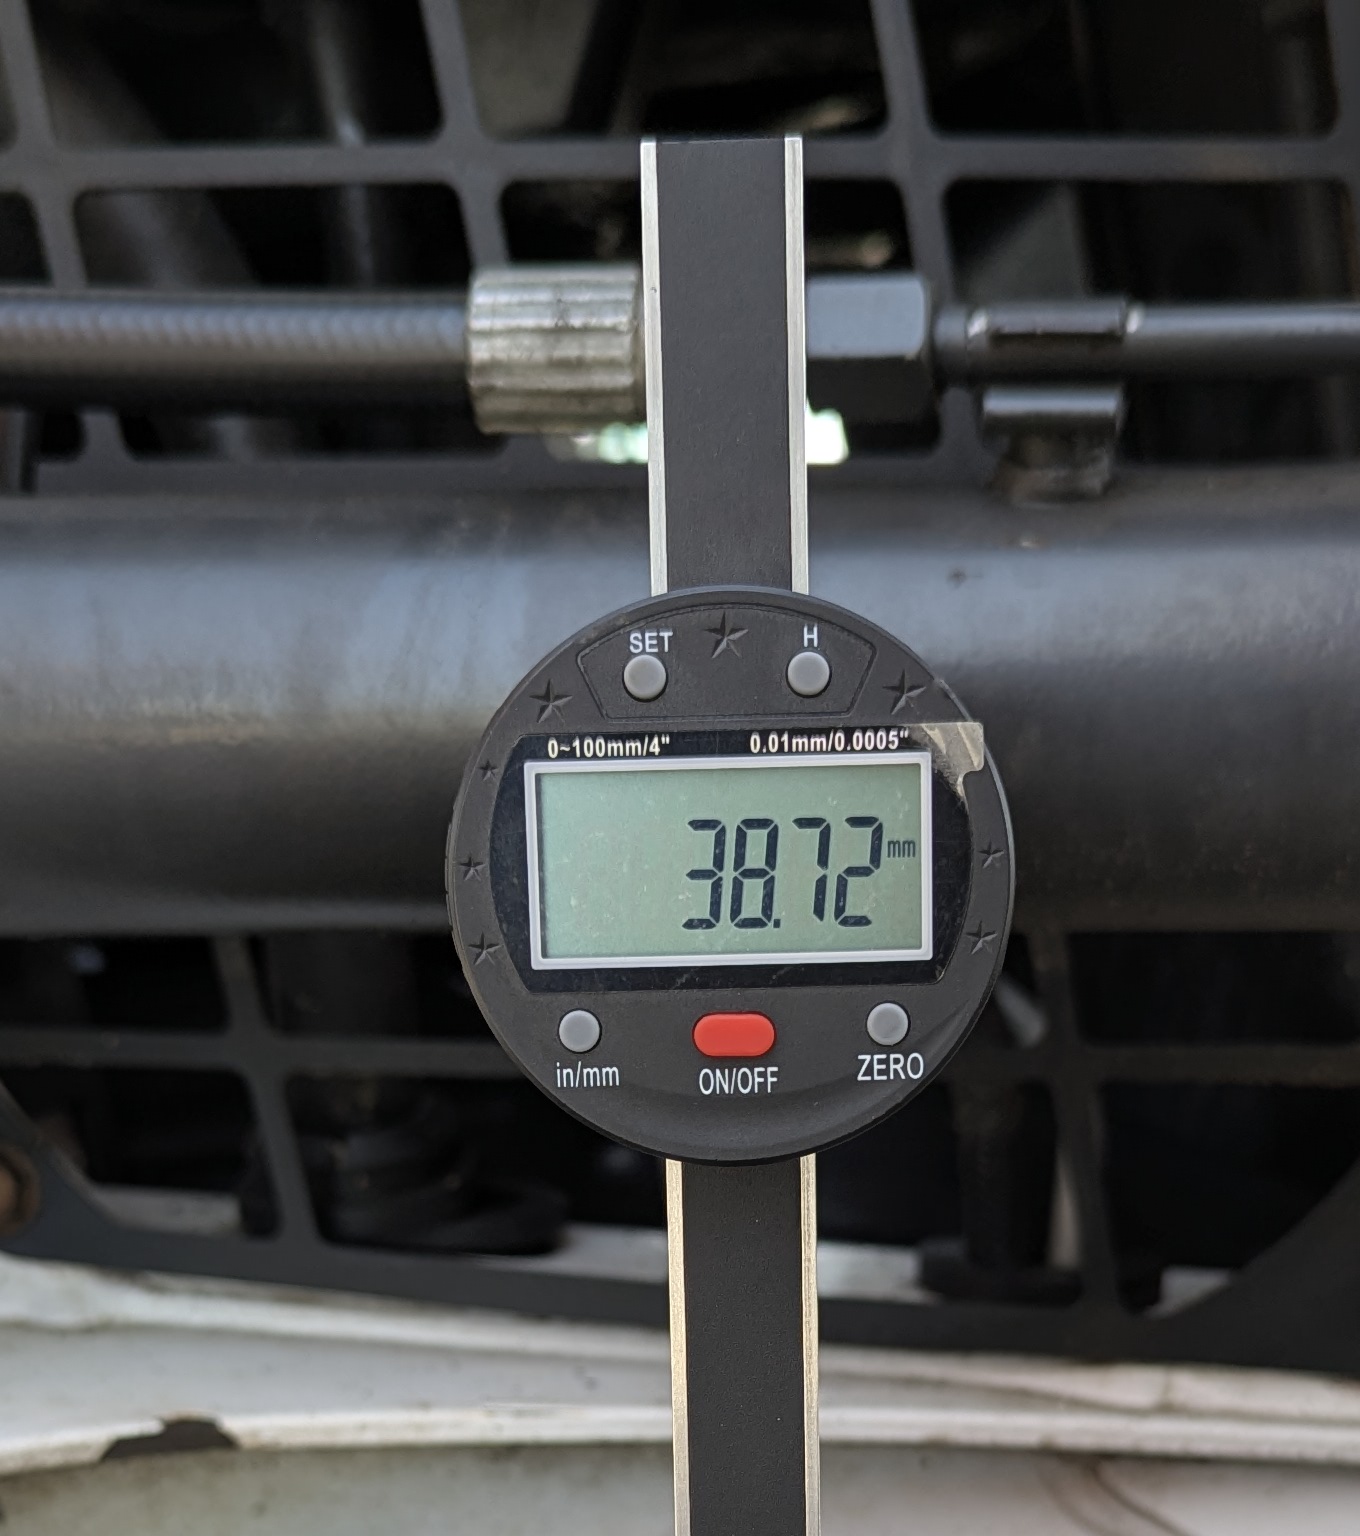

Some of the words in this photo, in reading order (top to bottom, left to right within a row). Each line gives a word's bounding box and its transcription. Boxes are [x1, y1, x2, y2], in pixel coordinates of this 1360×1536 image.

[629, 631, 673, 654] SET
[802, 626, 818, 648] H
[547, 735, 670, 758] 0~100mm/4"
[749, 728, 909, 754] 0.01mm/0.0005"
[681, 816, 884, 931] 38.72
[887, 836, 917, 859] mm
[556, 1062, 620, 1088] in/mm
[856, 1052, 925, 1082] ZERO
[698, 1066, 779, 1096] ON/OFF
